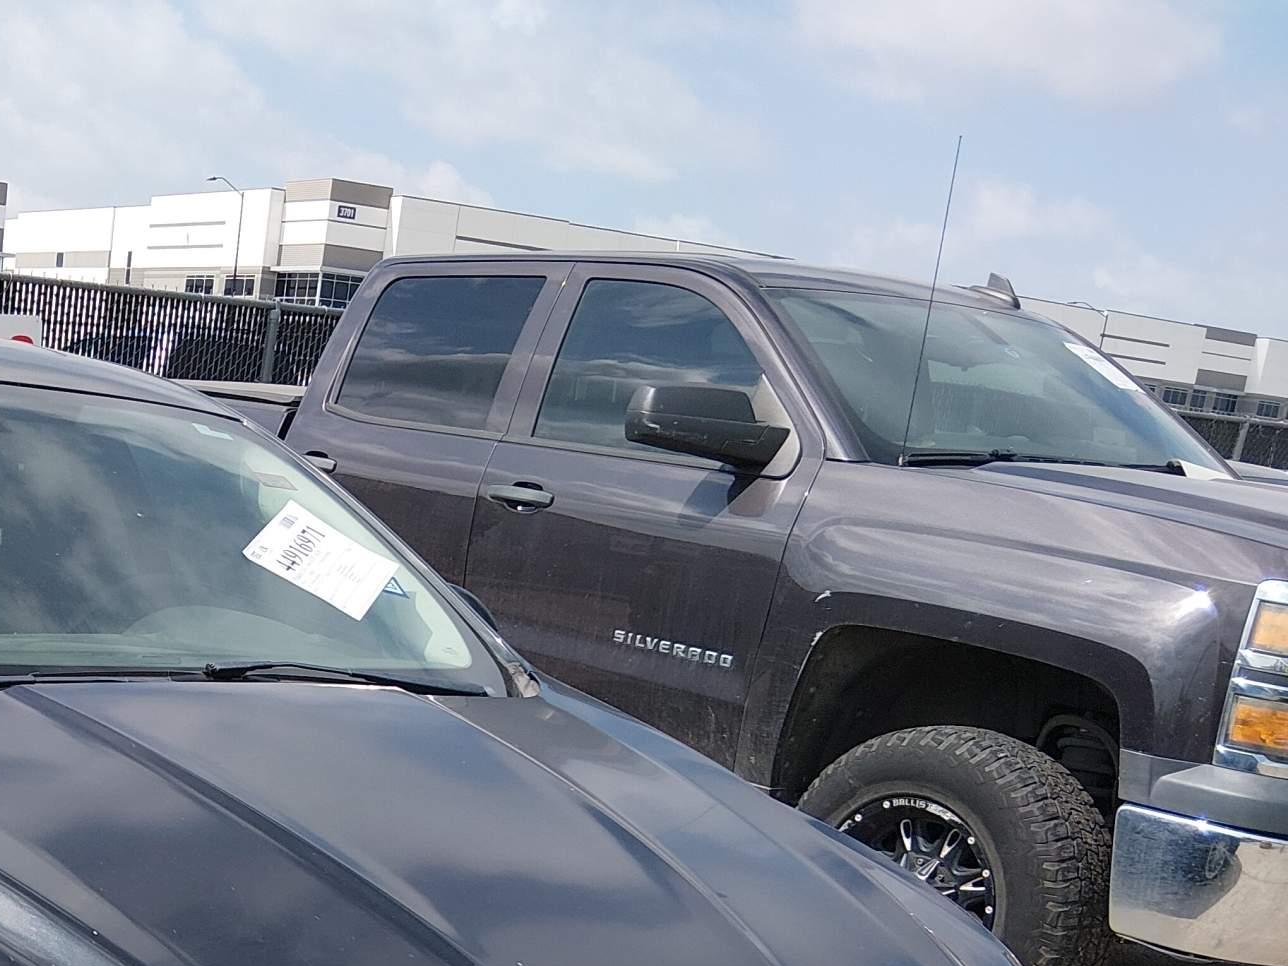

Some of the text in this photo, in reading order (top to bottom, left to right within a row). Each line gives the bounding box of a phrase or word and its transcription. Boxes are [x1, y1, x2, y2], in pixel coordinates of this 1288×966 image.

[339, 207, 355, 217] 3701
[276, 526, 326, 571] 44916971
[613, 629, 734, 668] SILVERADO
